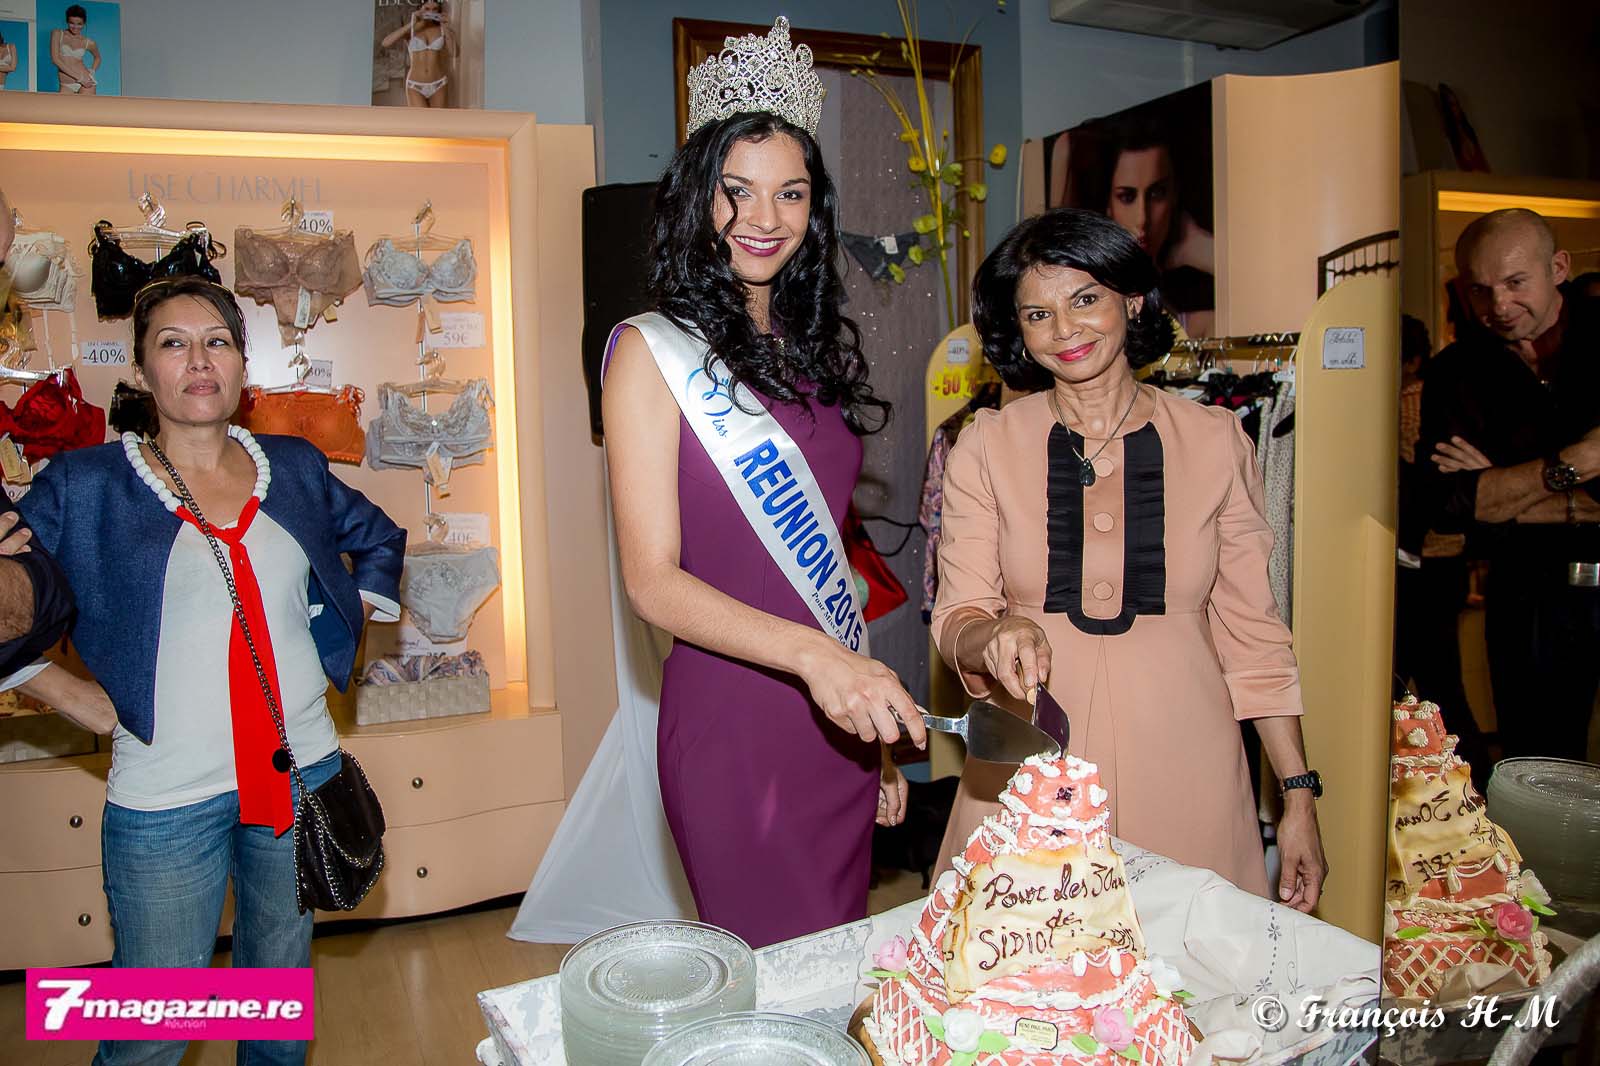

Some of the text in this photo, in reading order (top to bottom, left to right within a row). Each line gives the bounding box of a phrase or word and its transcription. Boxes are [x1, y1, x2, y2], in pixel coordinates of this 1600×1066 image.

[127, 167, 177, 201] LISE
[83, 349, 126, 363] -40%
[734, 438, 863, 653] REUNION 2015
[812, 592, 825, 611] Pour
